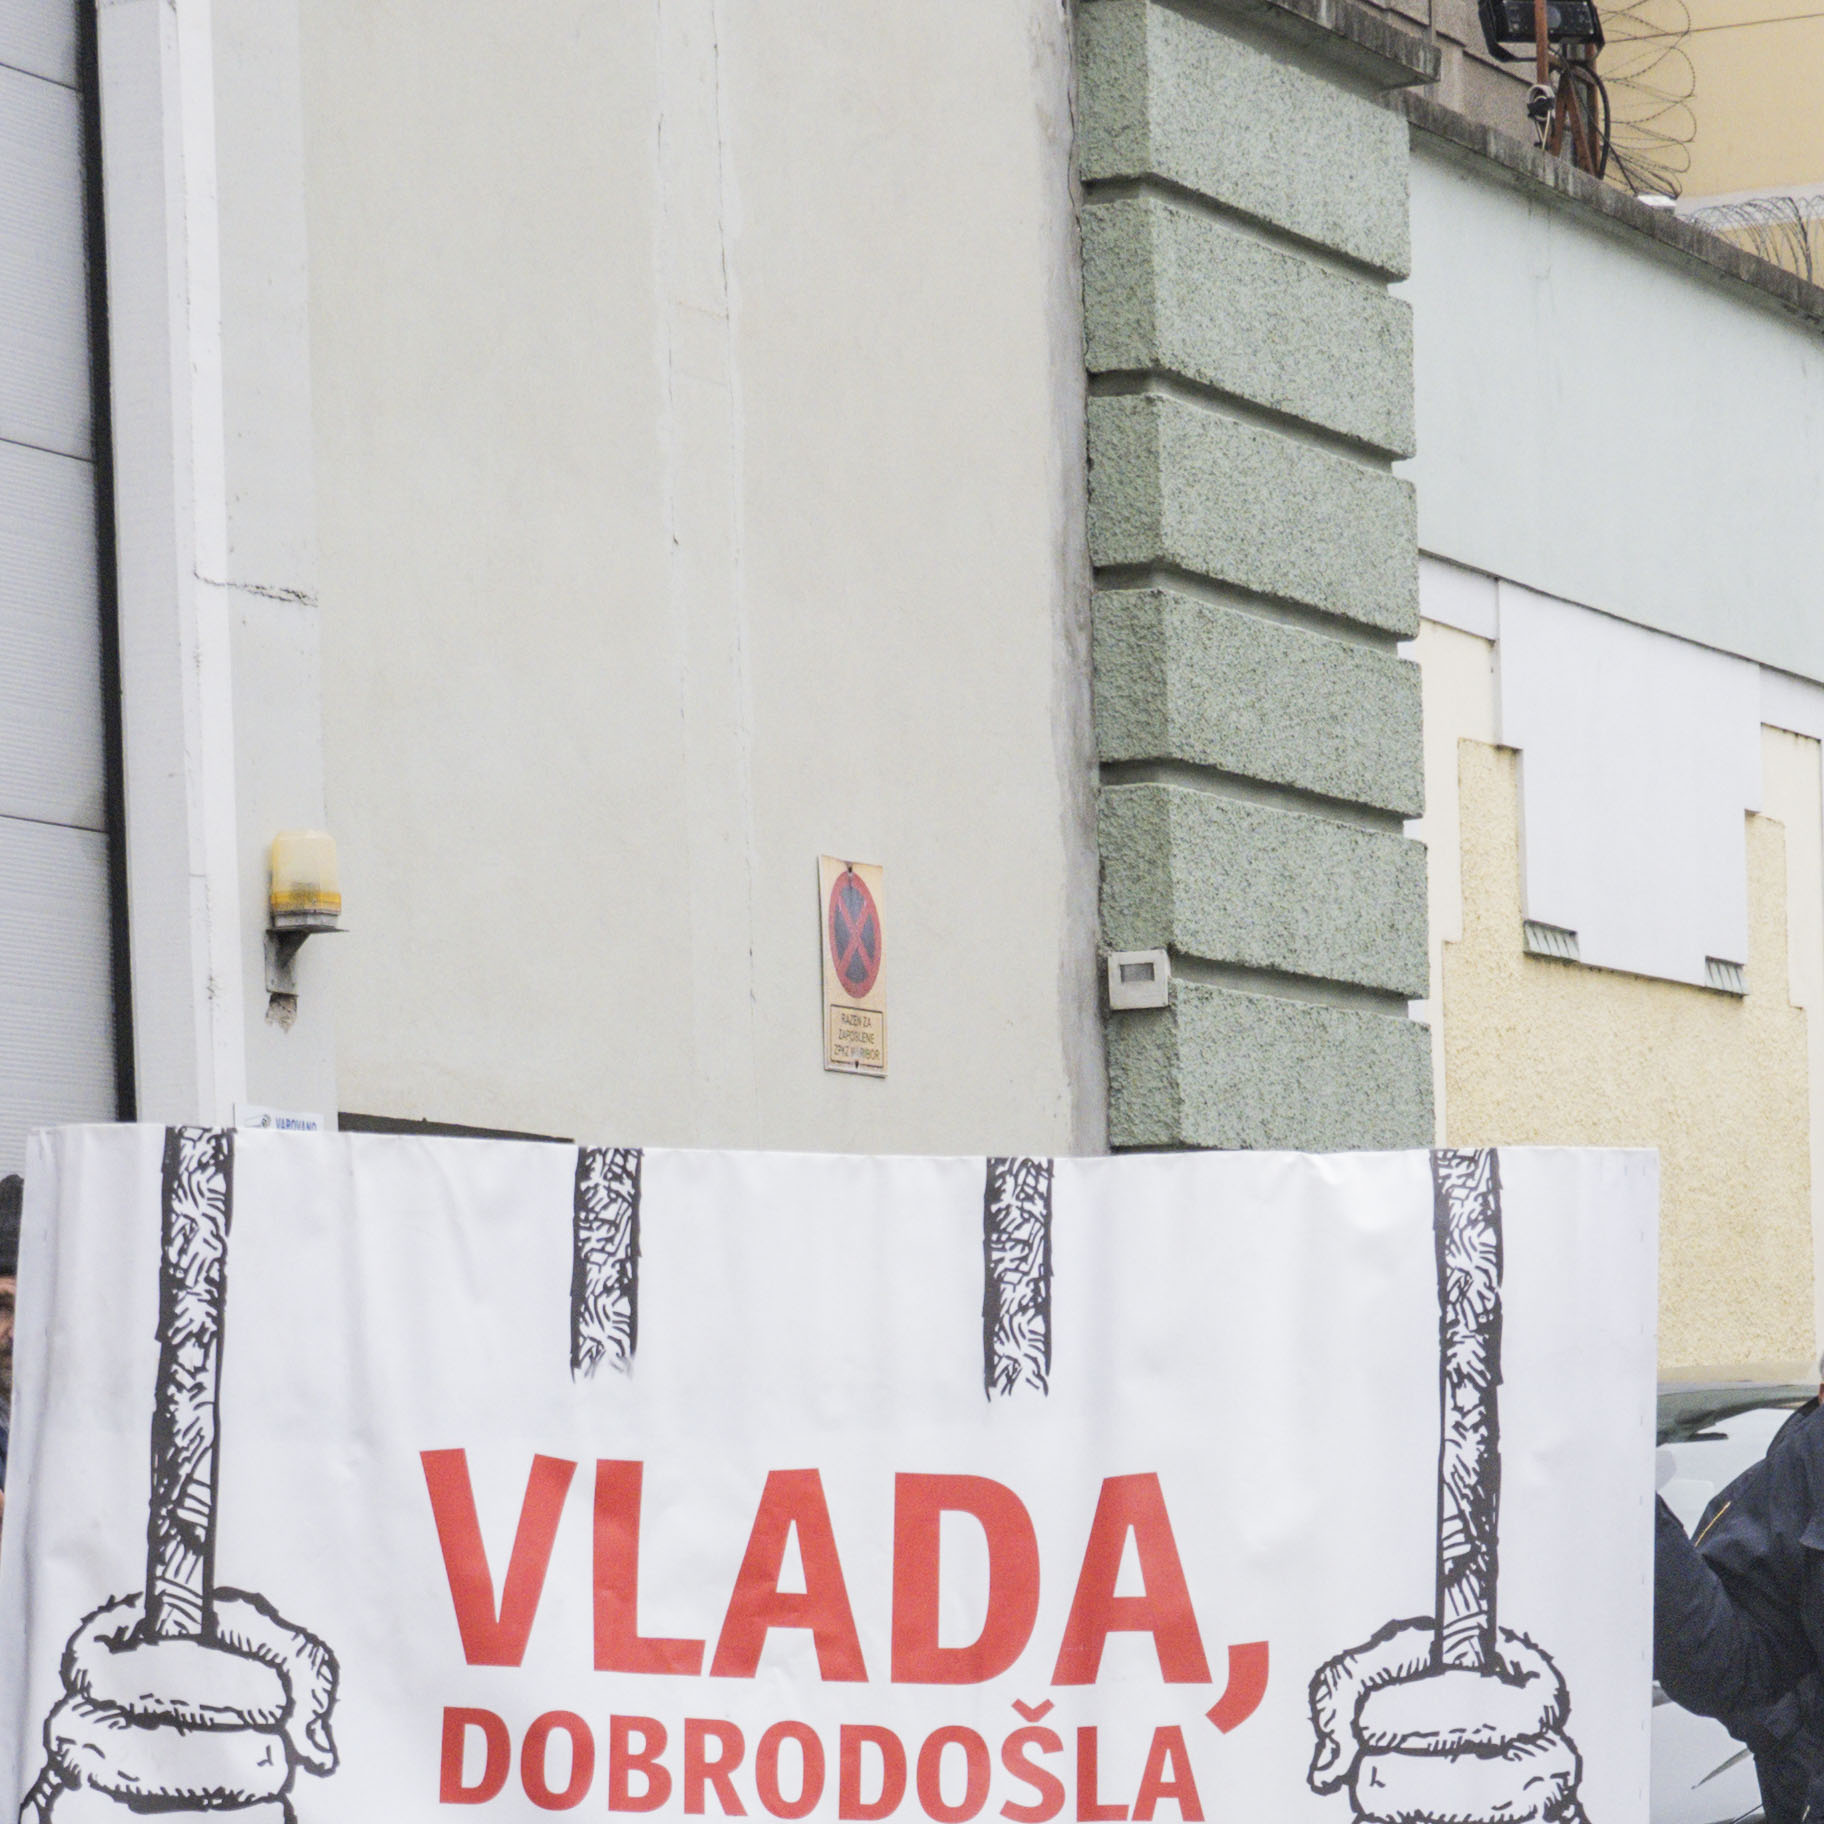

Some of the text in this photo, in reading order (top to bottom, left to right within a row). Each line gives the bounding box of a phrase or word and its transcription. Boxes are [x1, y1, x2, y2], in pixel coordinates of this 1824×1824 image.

[841, 1012, 872, 1028] RAZEN ZA
[421, 1448, 1269, 1733] VLADA,
[440, 1699, 1204, 1823] DOBRODOŠLA
